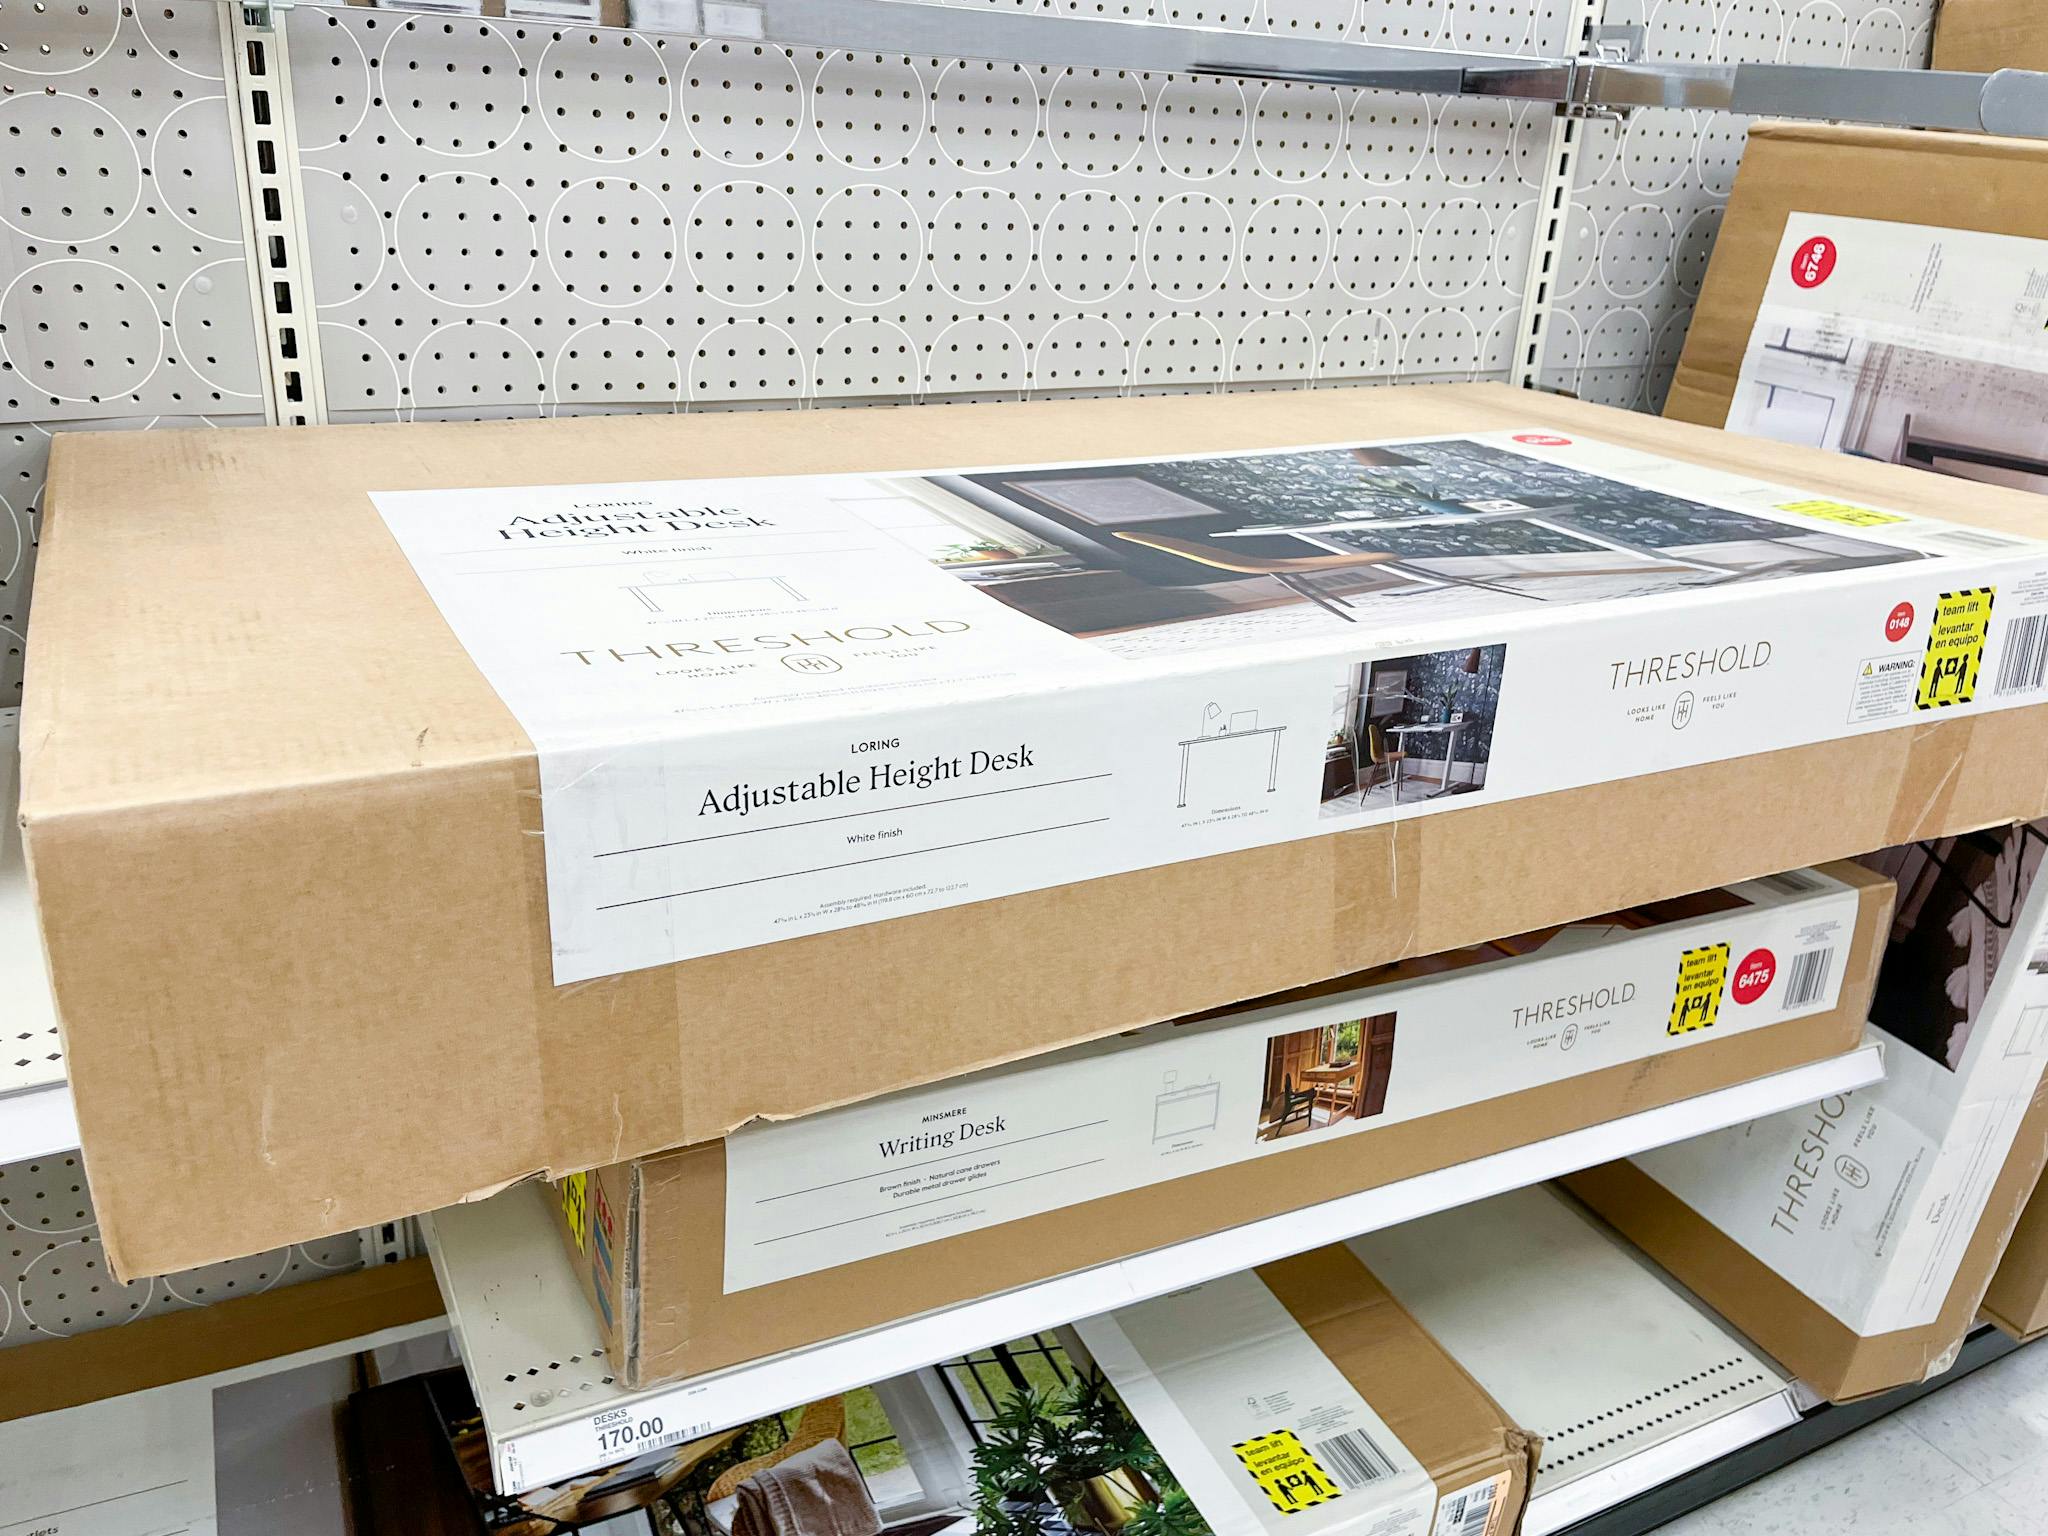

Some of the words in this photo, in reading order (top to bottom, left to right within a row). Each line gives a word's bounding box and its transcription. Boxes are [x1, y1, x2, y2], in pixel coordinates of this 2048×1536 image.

[1804, 243, 1826, 282] 6746
[508, 506, 743, 526] Adjustable
[499, 523, 657, 540] Height
[665, 517, 777, 532] Desk
[1942, 604, 1965, 617] team
[1966, 601, 1979, 613] lift
[1889, 616, 1911, 630] 0148
[1938, 621, 1976, 636] levantar
[560, 620, 970, 665] THRESHOLD
[1935, 638, 1946, 649] en
[1948, 633, 1979, 648] equipo
[1611, 641, 1772, 690] THRESHOLD
[1878, 659, 1916, 673] WARNING:
[1702, 695, 1722, 703] FEELS
[1722, 691, 1737, 700] LIKE
[1627, 706, 1650, 716] LOOKS
[1651, 703, 1667, 712] LIKE
[1712, 702, 1725, 710] YOU
[1635, 714, 1655, 722] HOME
[850, 738, 900, 754] LORING
[697, 769, 861, 817] Adjustable
[870, 756, 963, 789] Height
[970, 743, 1034, 776] Desk
[846, 832, 876, 845] White
[877, 827, 903, 840] finish
[819, 898, 846, 909] Assembly
[873, 889, 901, 898] Hardware
[1686, 956, 1706, 967] team
[1707, 953, 1718, 964] lift
[1683, 968, 1714, 982] levantar
[1738, 968, 1770, 989] 6475
[1682, 983, 1693, 992] en
[1694, 976, 1719, 990] equipo
[1512, 982, 1636, 1029] THRESHOLD
[921, 1107, 968, 1124] MINSMERE
[879, 1130, 956, 1158] Writing
[959, 1115, 1007, 1141] Desk
[879, 1182, 902, 1193] Brown
[903, 1177, 921, 1188] finish
[929, 1169, 956, 1181] Natural
[956, 1166, 973, 1175] cane
[973, 1160, 1001, 1171] drawers
[892, 1187, 921, 1199] Durable
[921, 1181, 941, 1192] metal
[942, 1176, 966, 1187] drawer
[967, 1171, 988, 1183] glides
[593, 1408, 628, 1426] DESKS
[594, 1416, 634, 1433] THRESHOLD
[597, 1416, 664, 1450] 170.00
[1244, 1444, 1270, 1456] team
[1269, 1439, 1284, 1448] lift
[1252, 1451, 1290, 1468] levantar
[1260, 1467, 1273, 1476] en
[1273, 1456, 1305, 1471] equipo
